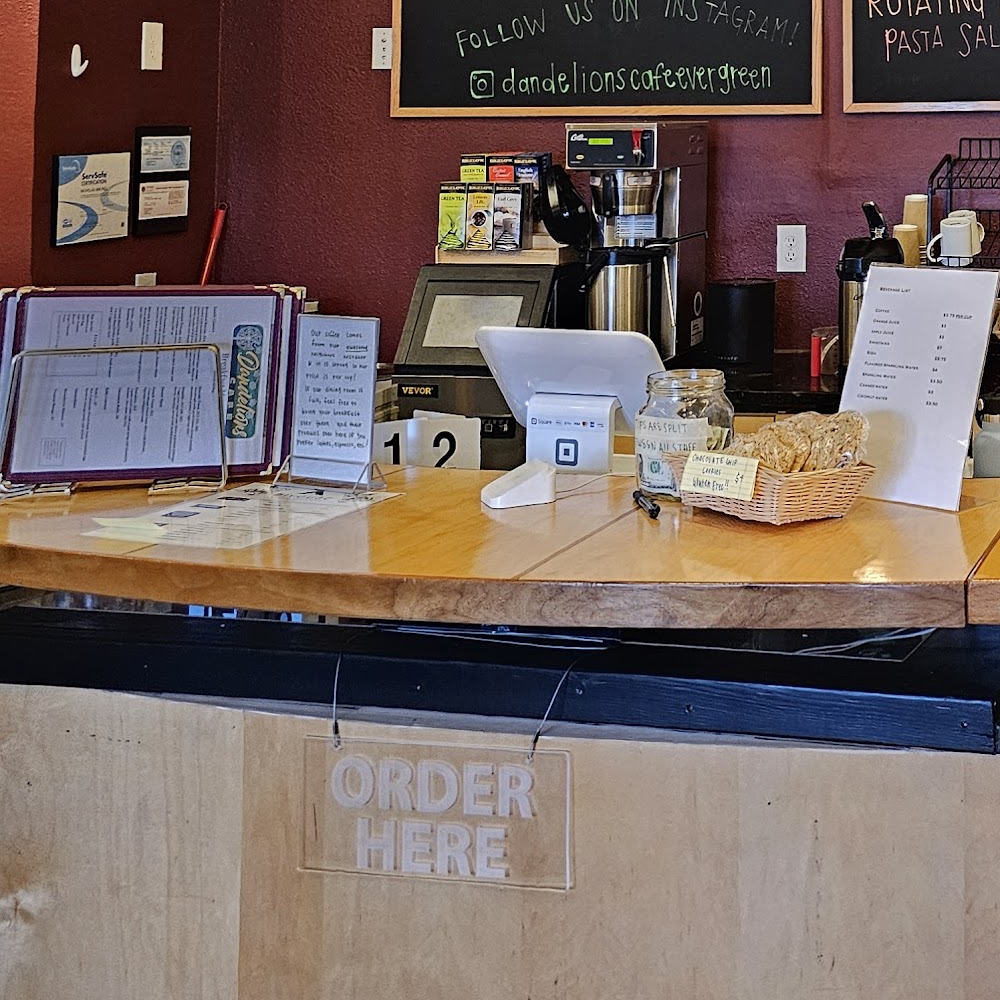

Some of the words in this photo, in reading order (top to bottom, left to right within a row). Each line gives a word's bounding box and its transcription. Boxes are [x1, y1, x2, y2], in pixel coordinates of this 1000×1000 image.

[455, 8, 547, 58] FOLLOW
[885, 27, 943, 61] PASTA
[502, 62, 772, 95] dandelionscafeevergreen
[82, 171, 107, 180] ServSafe
[232, 351, 260, 438] Dandelions
[402, 386, 431, 395] VEVOR
[663, 422, 688, 434] SPLIT
[384, 432, 400, 465] 1
[432, 430, 457, 468] 2
[692, 453, 724, 465] CHOCOLATE
[725, 457, 738, 467] CHIP
[330, 754, 537, 820] ORDER
[356, 817, 510, 879] HERE
